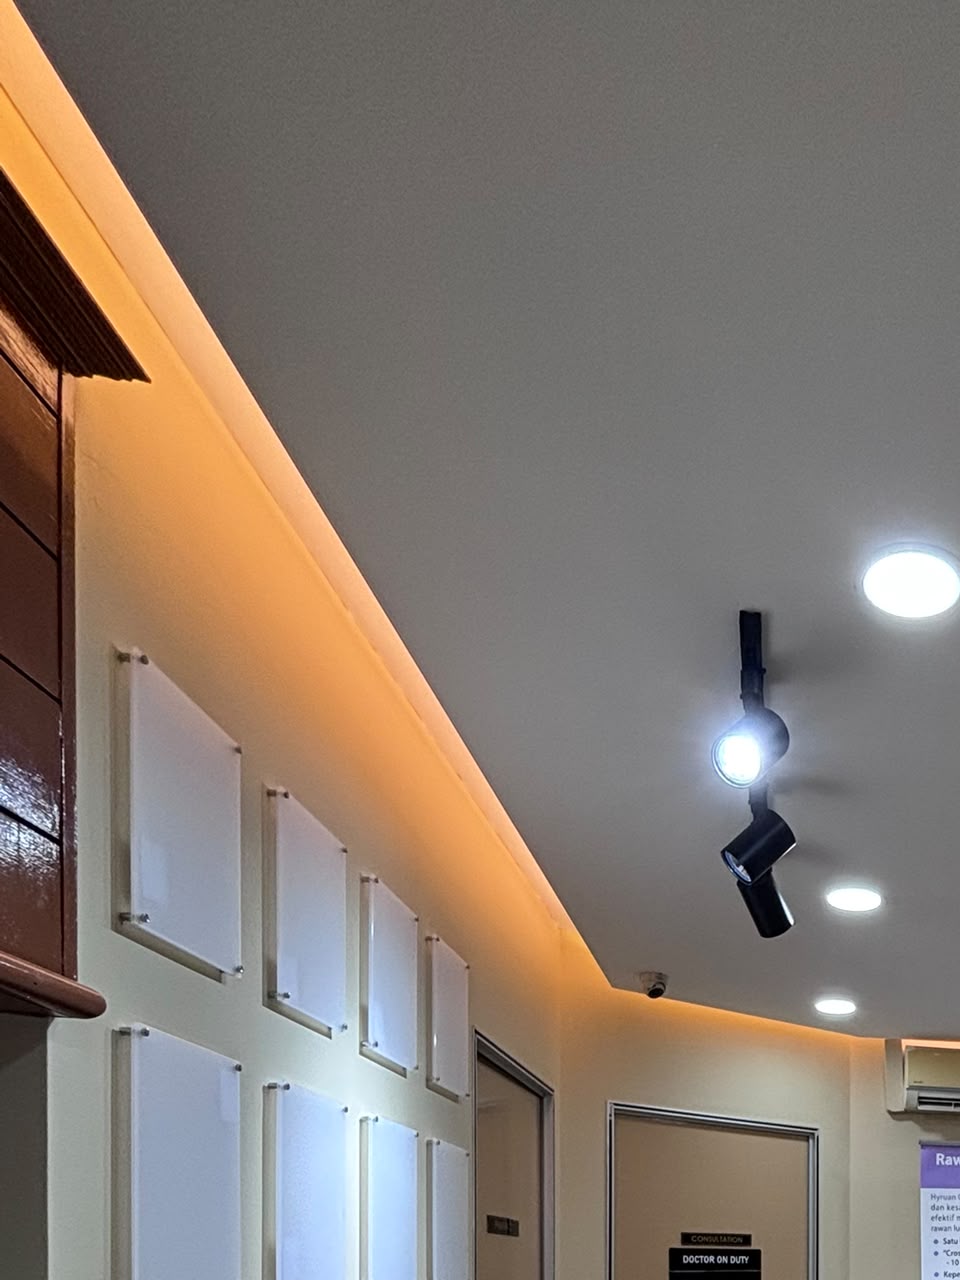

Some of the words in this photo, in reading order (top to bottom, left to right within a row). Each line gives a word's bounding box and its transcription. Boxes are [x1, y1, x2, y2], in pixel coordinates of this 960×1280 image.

[691, 1235, 743, 1243] CONSULTATION
[682, 1255, 715, 1263] DOCTOR
[717, 1256, 728, 1264] ON
[730, 1256, 749, 1264] DUTY
